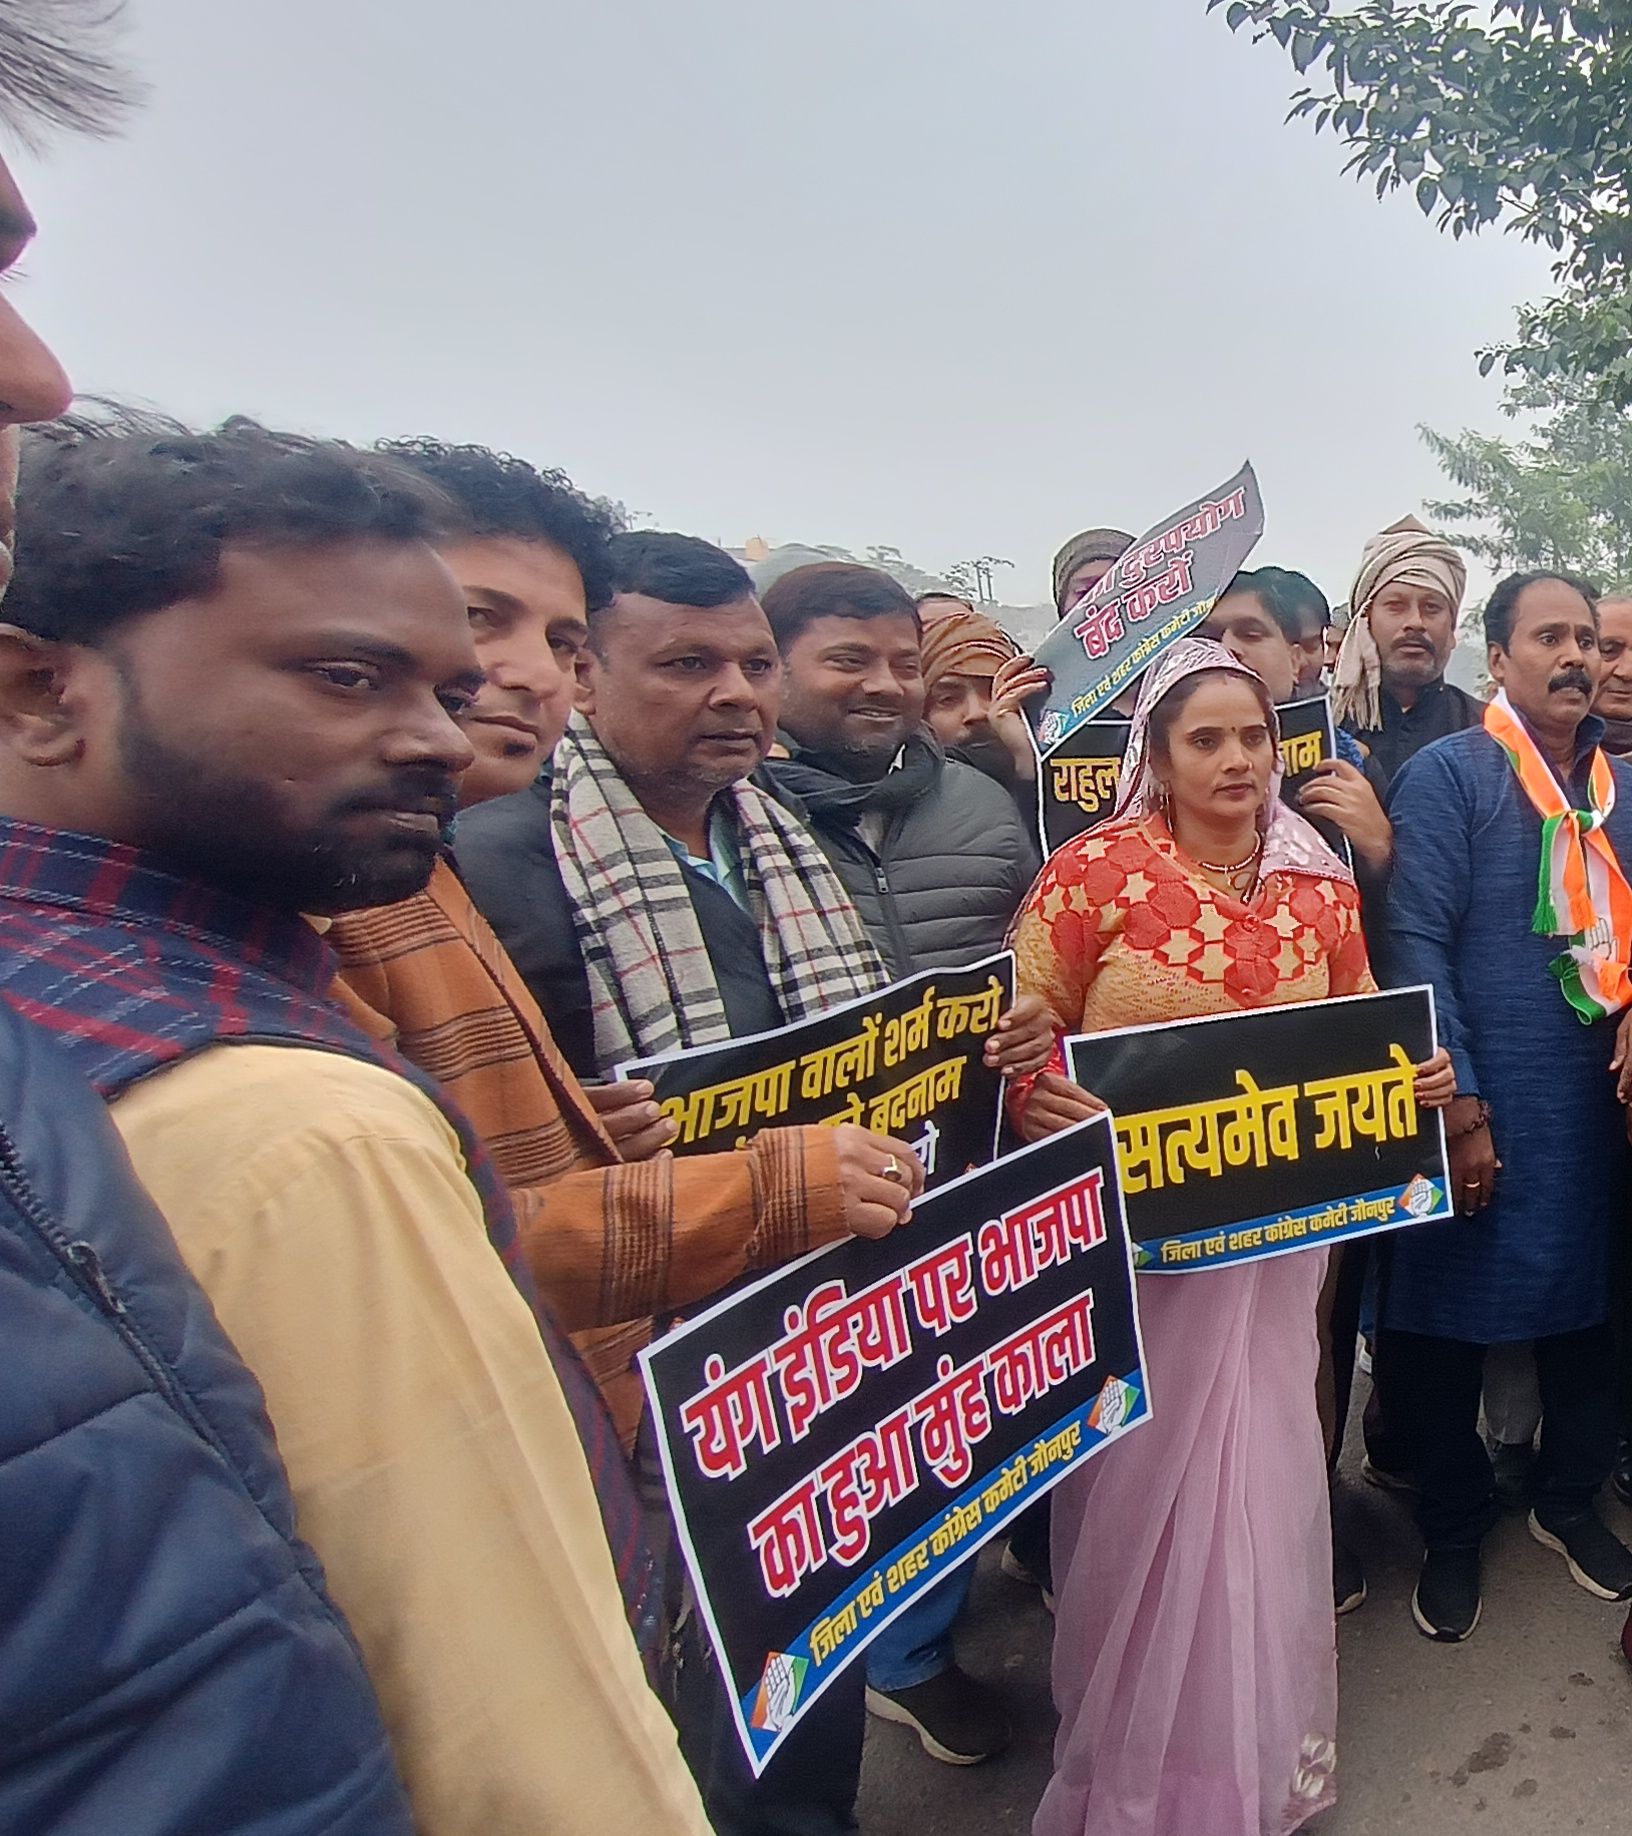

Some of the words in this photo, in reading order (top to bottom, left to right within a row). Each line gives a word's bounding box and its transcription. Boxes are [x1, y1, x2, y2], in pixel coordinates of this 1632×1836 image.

[1074, 598, 1125, 660] बंद
[1121, 550, 1194, 623] करों
[1050, 757, 1121, 812] राहुल
[660, 1060, 796, 1147] भाजपा
[799, 1012, 883, 1098] वालों
[883, 984, 939, 1067] शर्म
[936, 976, 1004, 1039] करो
[869, 1056, 968, 1136] बदनाम
[1114, 1069, 1299, 1195] सत्यमेव
[1304, 1043, 1420, 1150] जयते
[1161, 1240, 1202, 1263] जिला
[1204, 1230, 1226, 1256] एवं
[1228, 1227, 1262, 1252] शहर
[1264, 1215, 1307, 1243] कांग्रेस
[1309, 1202, 1350, 1232] कमेटी
[1348, 1196, 1397, 1223] जौनपुर
[680, 1353, 782, 1480] यंग
[772, 1279, 913, 1443] इंडिया
[905, 1232, 976, 1338] पर
[977, 1165, 1108, 1296] भाजपा
[746, 1477, 831, 1598] का
[819, 1407, 919, 1568] हुआ
[911, 1353, 994, 1490] मुंह
[985, 1287, 1096, 1416] काला
[809, 1600, 858, 1668] जिला
[856, 1571, 885, 1618] एवं
[886, 1540, 930, 1594] शहर
[930, 1497, 983, 1557] कांग्रेस
[980, 1455, 1029, 1514] कमेटी
[1027, 1420, 1082, 1477] जौनपुर
